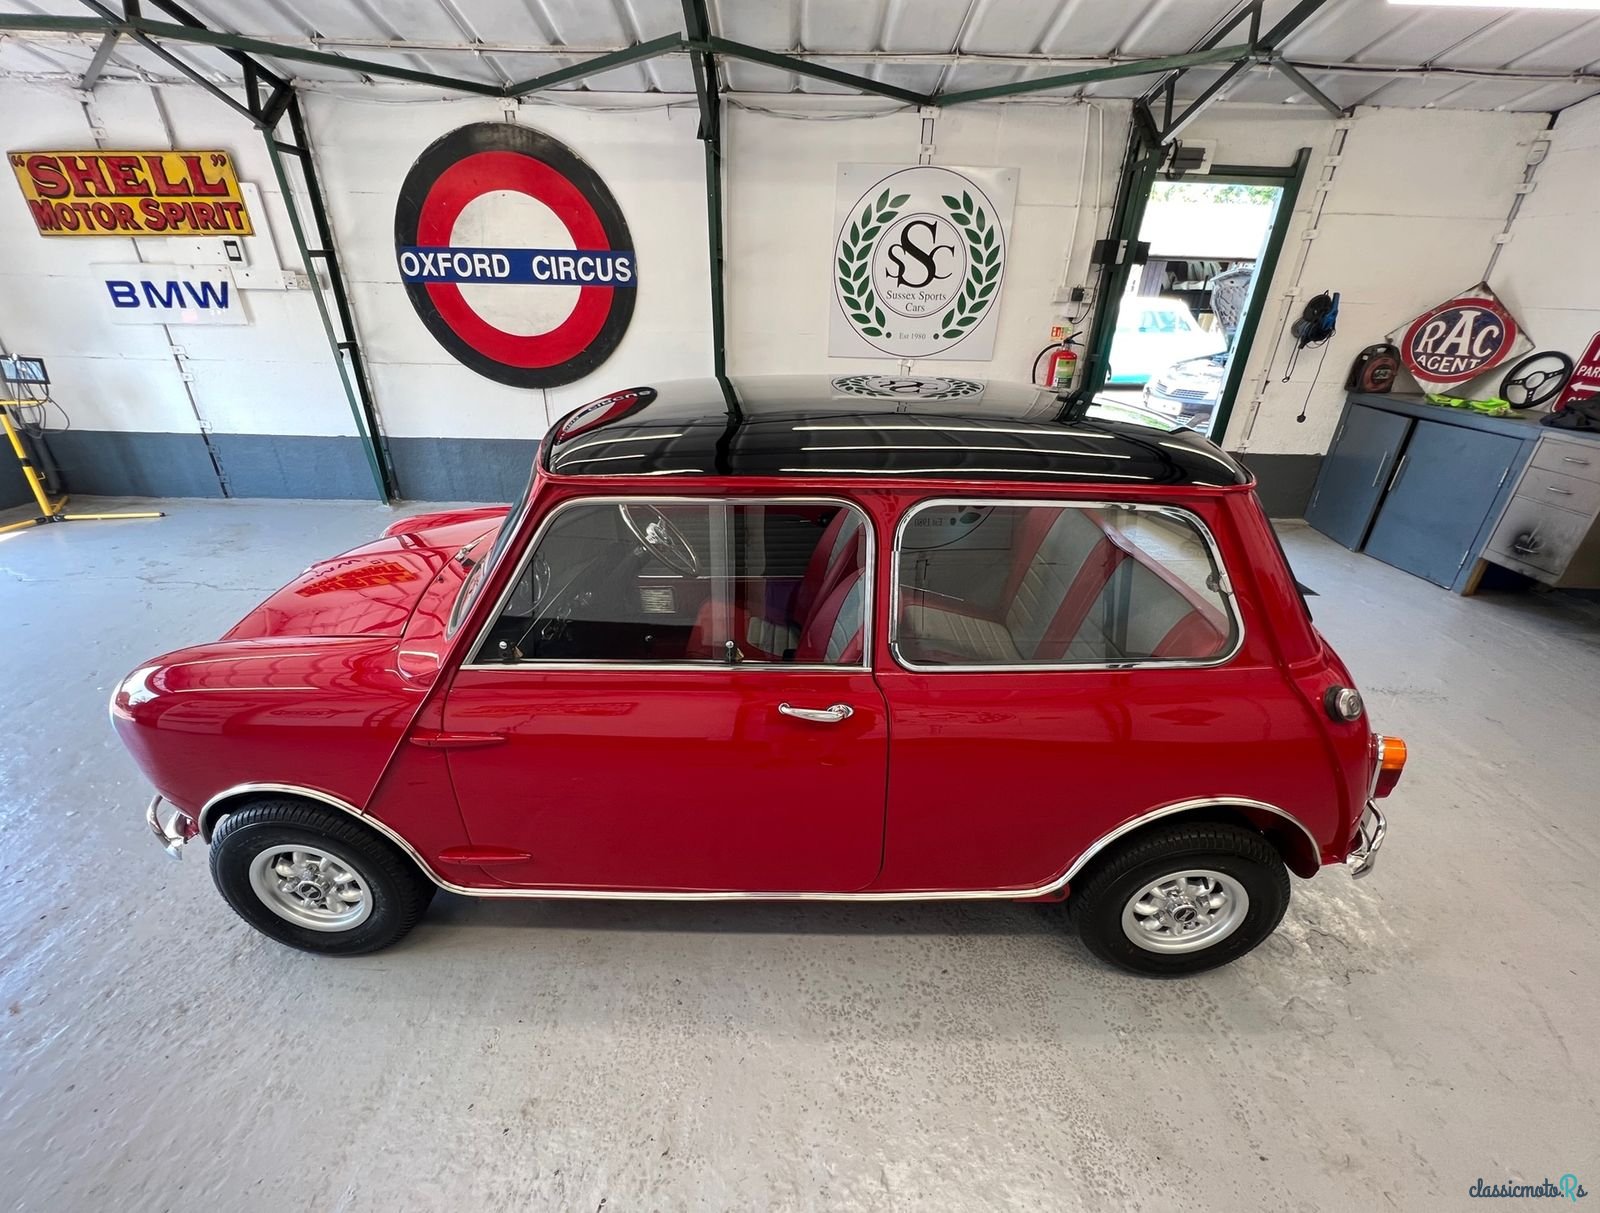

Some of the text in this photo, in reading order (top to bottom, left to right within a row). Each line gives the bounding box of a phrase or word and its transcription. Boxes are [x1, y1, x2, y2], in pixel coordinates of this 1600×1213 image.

[30, 198, 244, 230] MOTOR SPIRIT
[400, 252, 632, 282] OXFORD CIRCUS
[105, 280, 229, 309] BMW
[886, 290, 947, 302] Sussex Sports
[905, 303, 925, 312] Cars
[1417, 355, 1480, 372] AGENT
